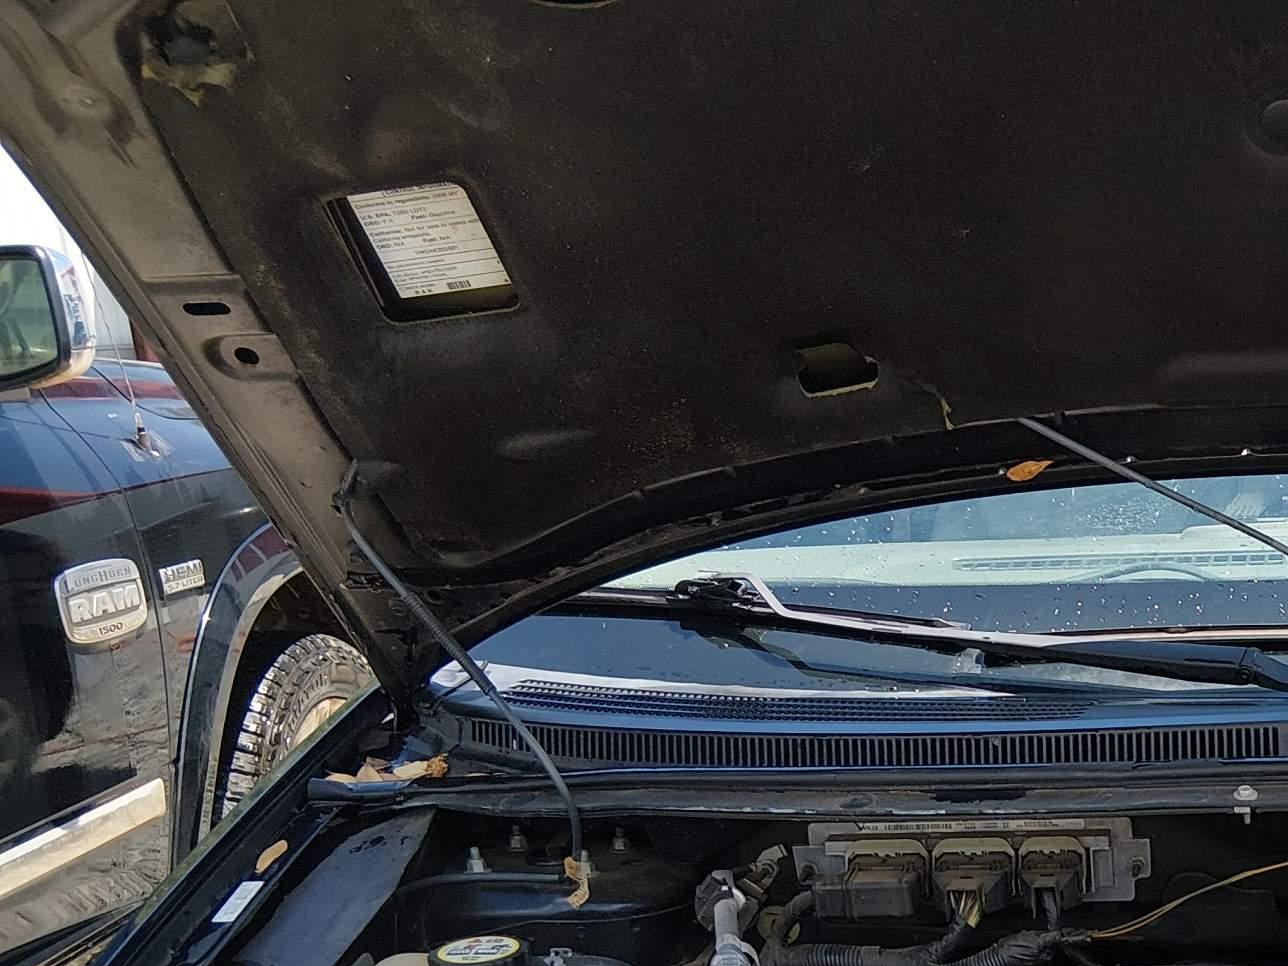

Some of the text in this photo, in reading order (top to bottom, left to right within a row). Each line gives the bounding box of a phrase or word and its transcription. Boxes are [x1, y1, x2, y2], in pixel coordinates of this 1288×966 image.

[164, 562, 203, 583] HEMI
[68, 584, 142, 624] RAM
[98, 622, 124, 636] 1500
